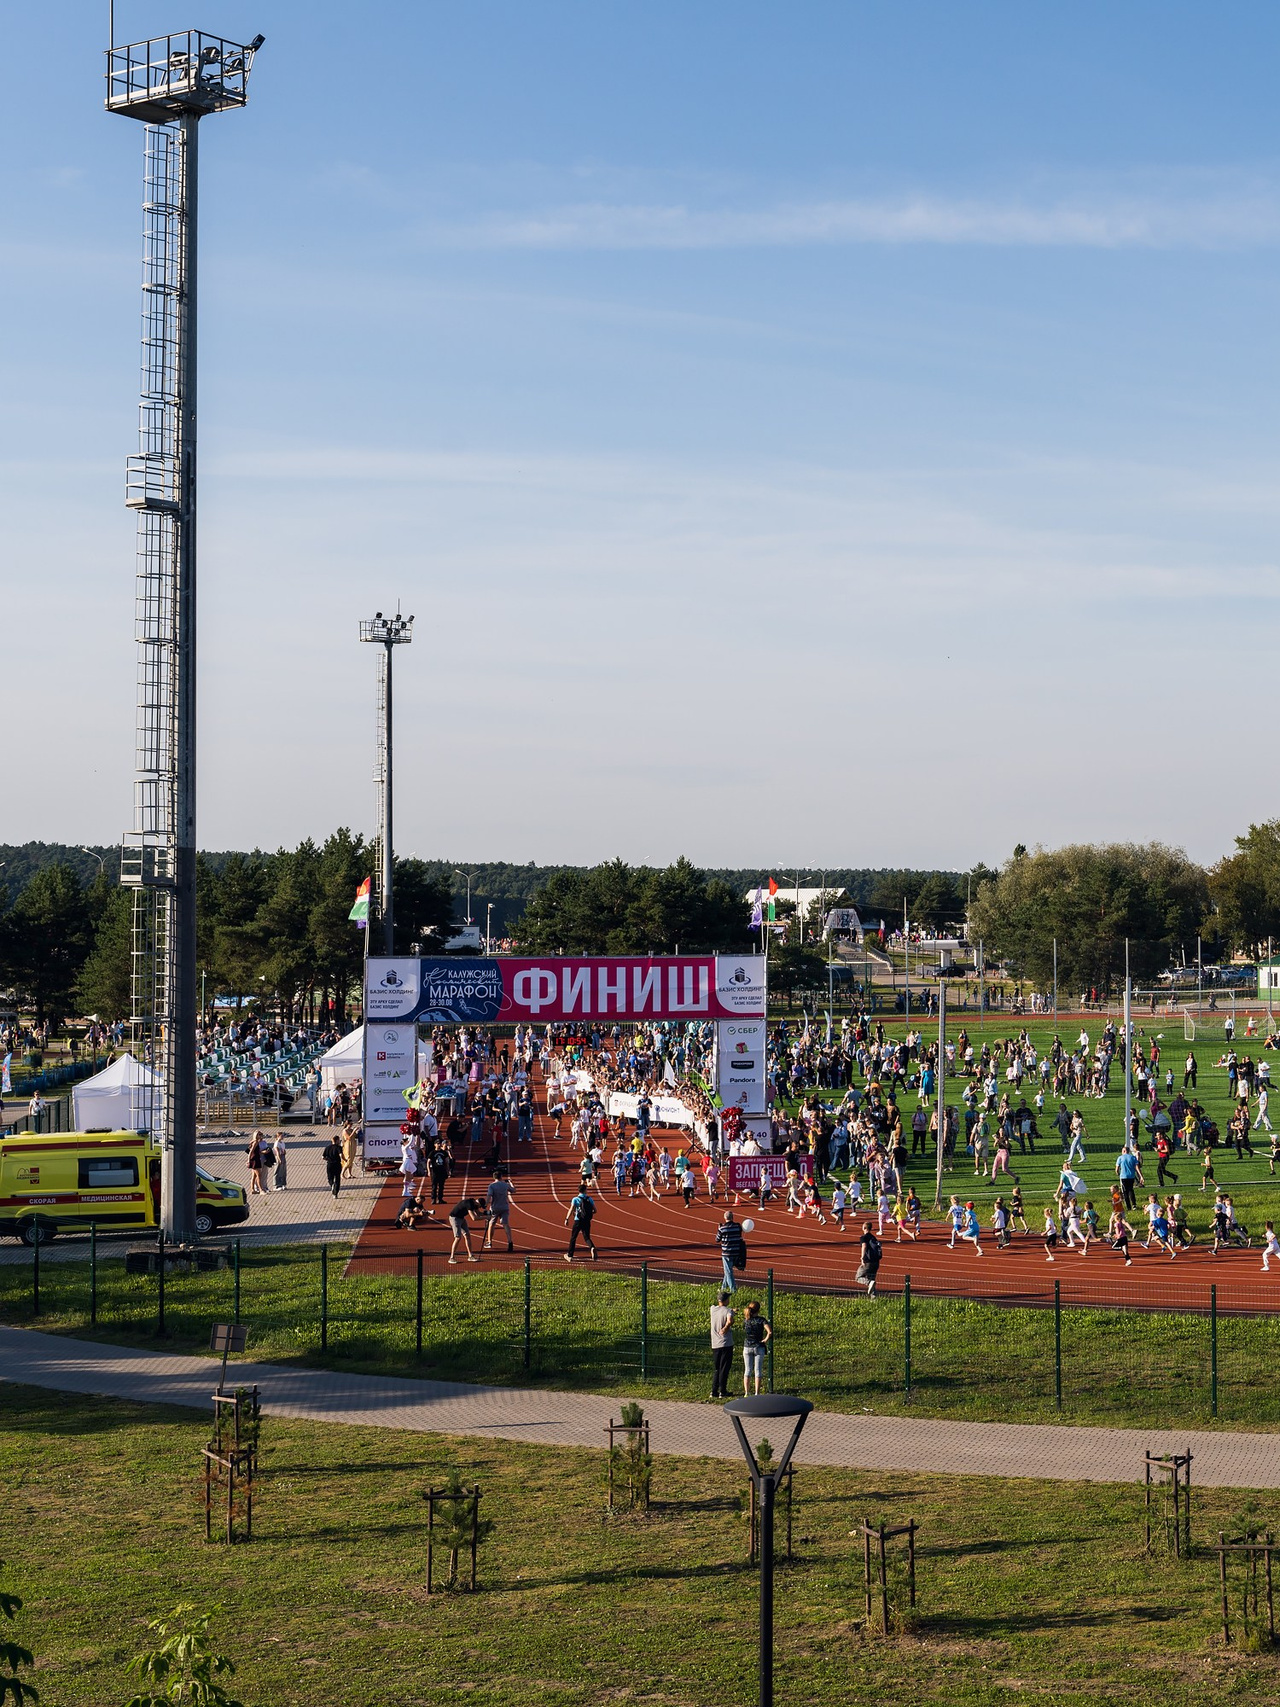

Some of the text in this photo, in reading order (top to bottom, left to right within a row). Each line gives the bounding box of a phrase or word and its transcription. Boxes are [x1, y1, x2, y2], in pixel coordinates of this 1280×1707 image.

[448, 968, 497, 979] КАЛУЖСКИЙ
[429, 985, 497, 999] МАРАФОН
[513, 965, 709, 1014] ФИНИШ
[368, 1139, 399, 1147] СПОРТ
[735, 1162, 808, 1180] ЗАПРЕЩО
